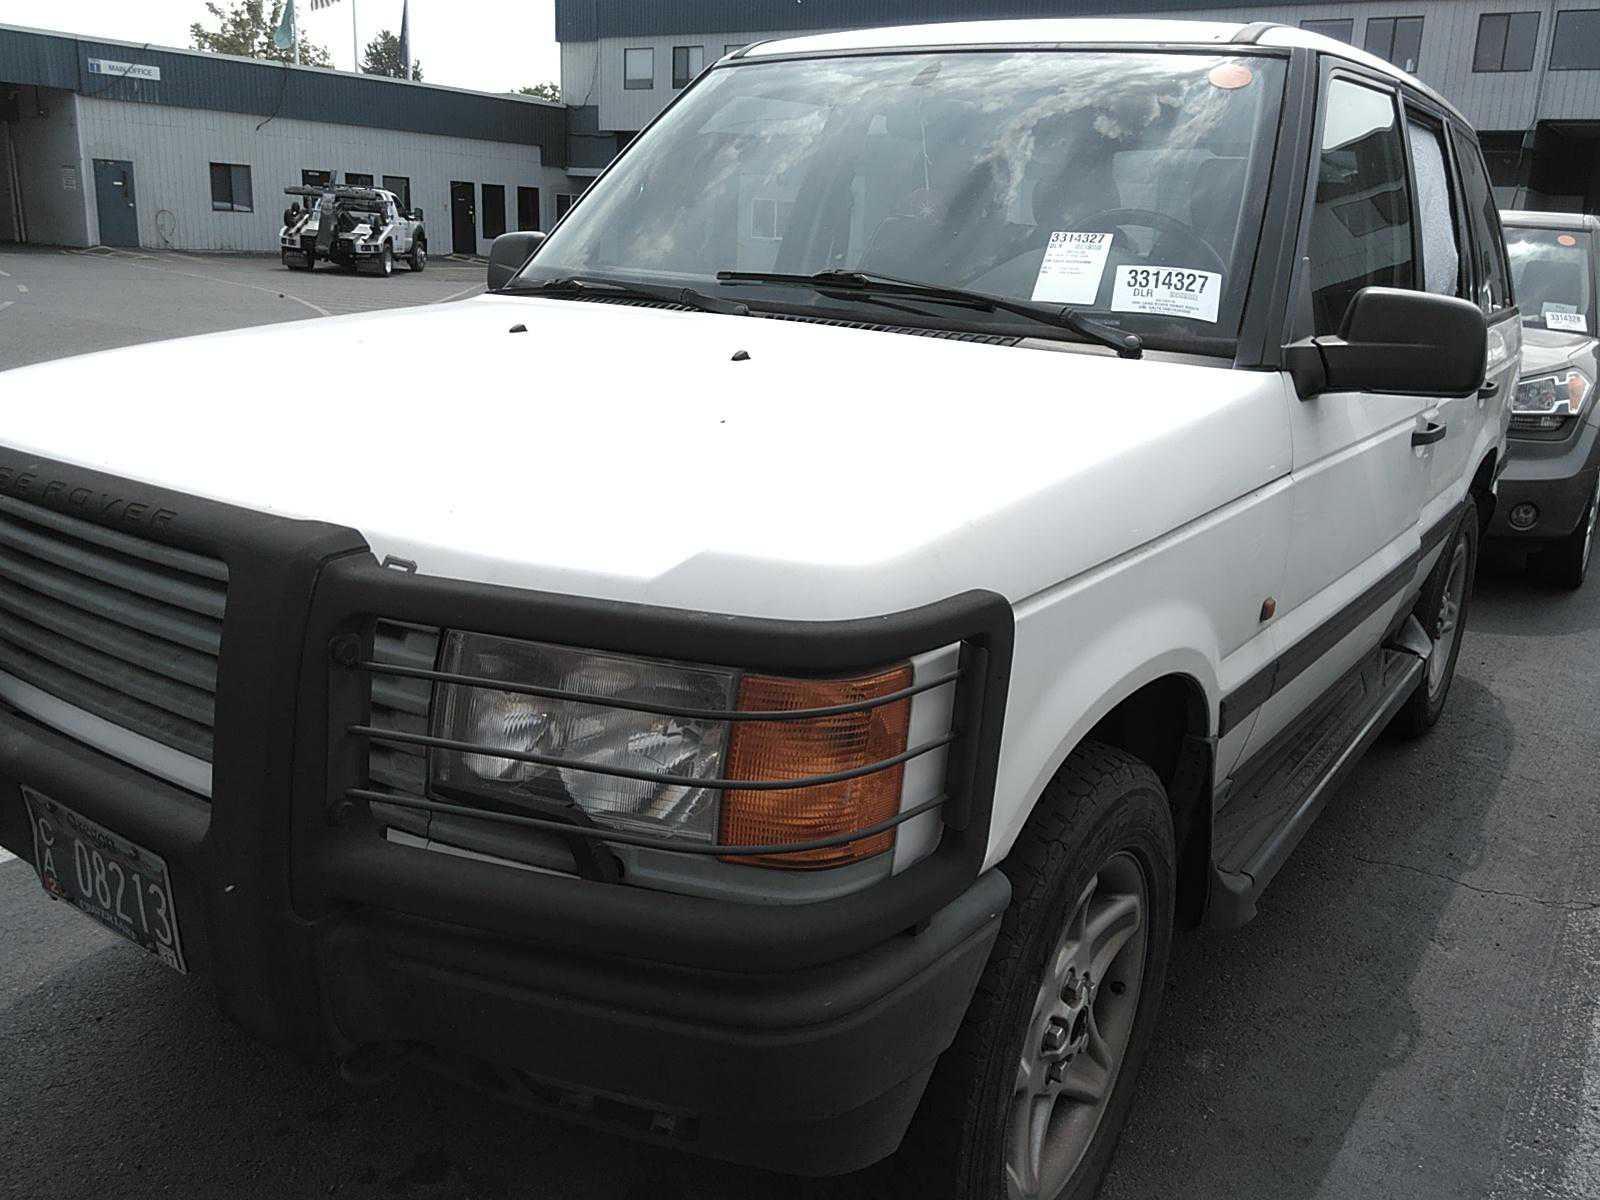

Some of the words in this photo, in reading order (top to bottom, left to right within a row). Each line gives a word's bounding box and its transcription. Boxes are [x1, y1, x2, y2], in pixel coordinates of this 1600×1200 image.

[108, 64, 126, 73] MAIN
[128, 67, 153, 77] OFFICE
[1051, 232, 1106, 244] 3314327
[1127, 269, 1209, 294] 3314327
[1133, 287, 1154, 298] DLR
[74, 838, 173, 946] 08213
